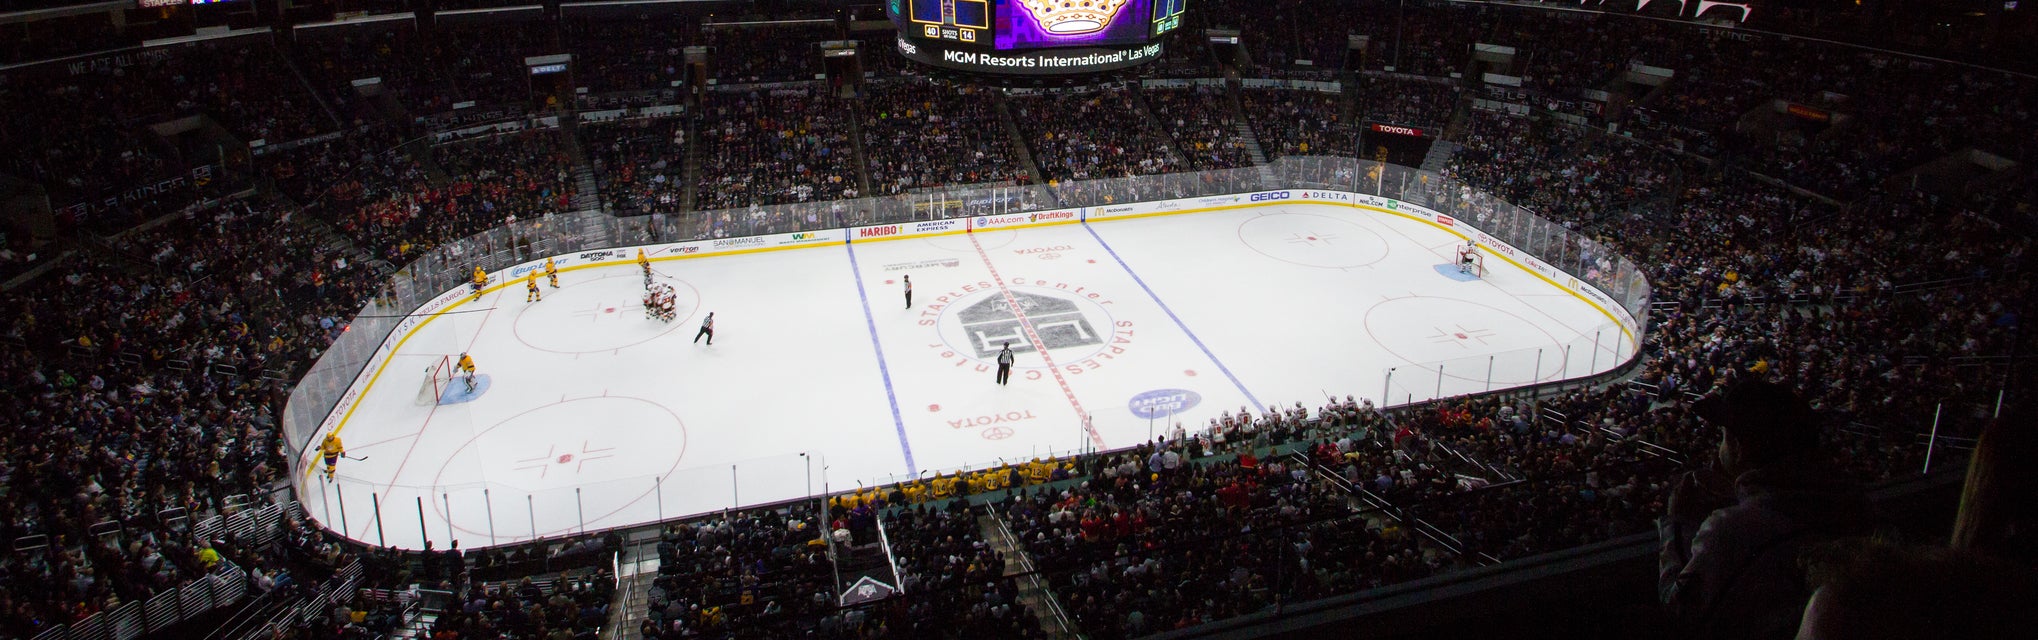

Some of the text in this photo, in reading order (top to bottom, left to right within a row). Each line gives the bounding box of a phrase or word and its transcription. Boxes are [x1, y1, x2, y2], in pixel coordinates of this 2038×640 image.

[927, 26, 937, 35] 40
[962, 30, 973, 40] 14
[944, 49, 976, 64] MGM
[979, 53, 1035, 67] Resorts
[1128, 49, 1143, 60] Las
[1143, 43, 1160, 57] Vegas
[1379, 124, 1414, 136] TOYOTA
[1250, 191, 1290, 202] GEICO
[1312, 191, 1348, 201] DELTA
[988, 215, 1024, 226] AAA.com
[1038, 210, 1074, 221] DraftKings
[916, 225, 949, 233] EXPRESS
[917, 220, 955, 228] AMERICAN
[860, 225, 897, 238] HARIBO
[713, 240, 730, 248] SAN
[734, 236, 766, 245] MANUEL
[1488, 237, 1515, 257] TOYOTA
[669, 244, 699, 254] verizon
[1014, 244, 1075, 255] TOYOTA
[580, 251, 613, 260] DAYTONA
[515, 264, 537, 276] BUD
[418, 288, 465, 317] WELLS FARGO
[918, 276, 1114, 328] STAPLES Center
[1061, 320, 1134, 376] STAPLES
[335, 389, 357, 416] TOYOTA
[1139, 401, 1182, 414] BUD
[947, 408, 1037, 430] TOYOTA
